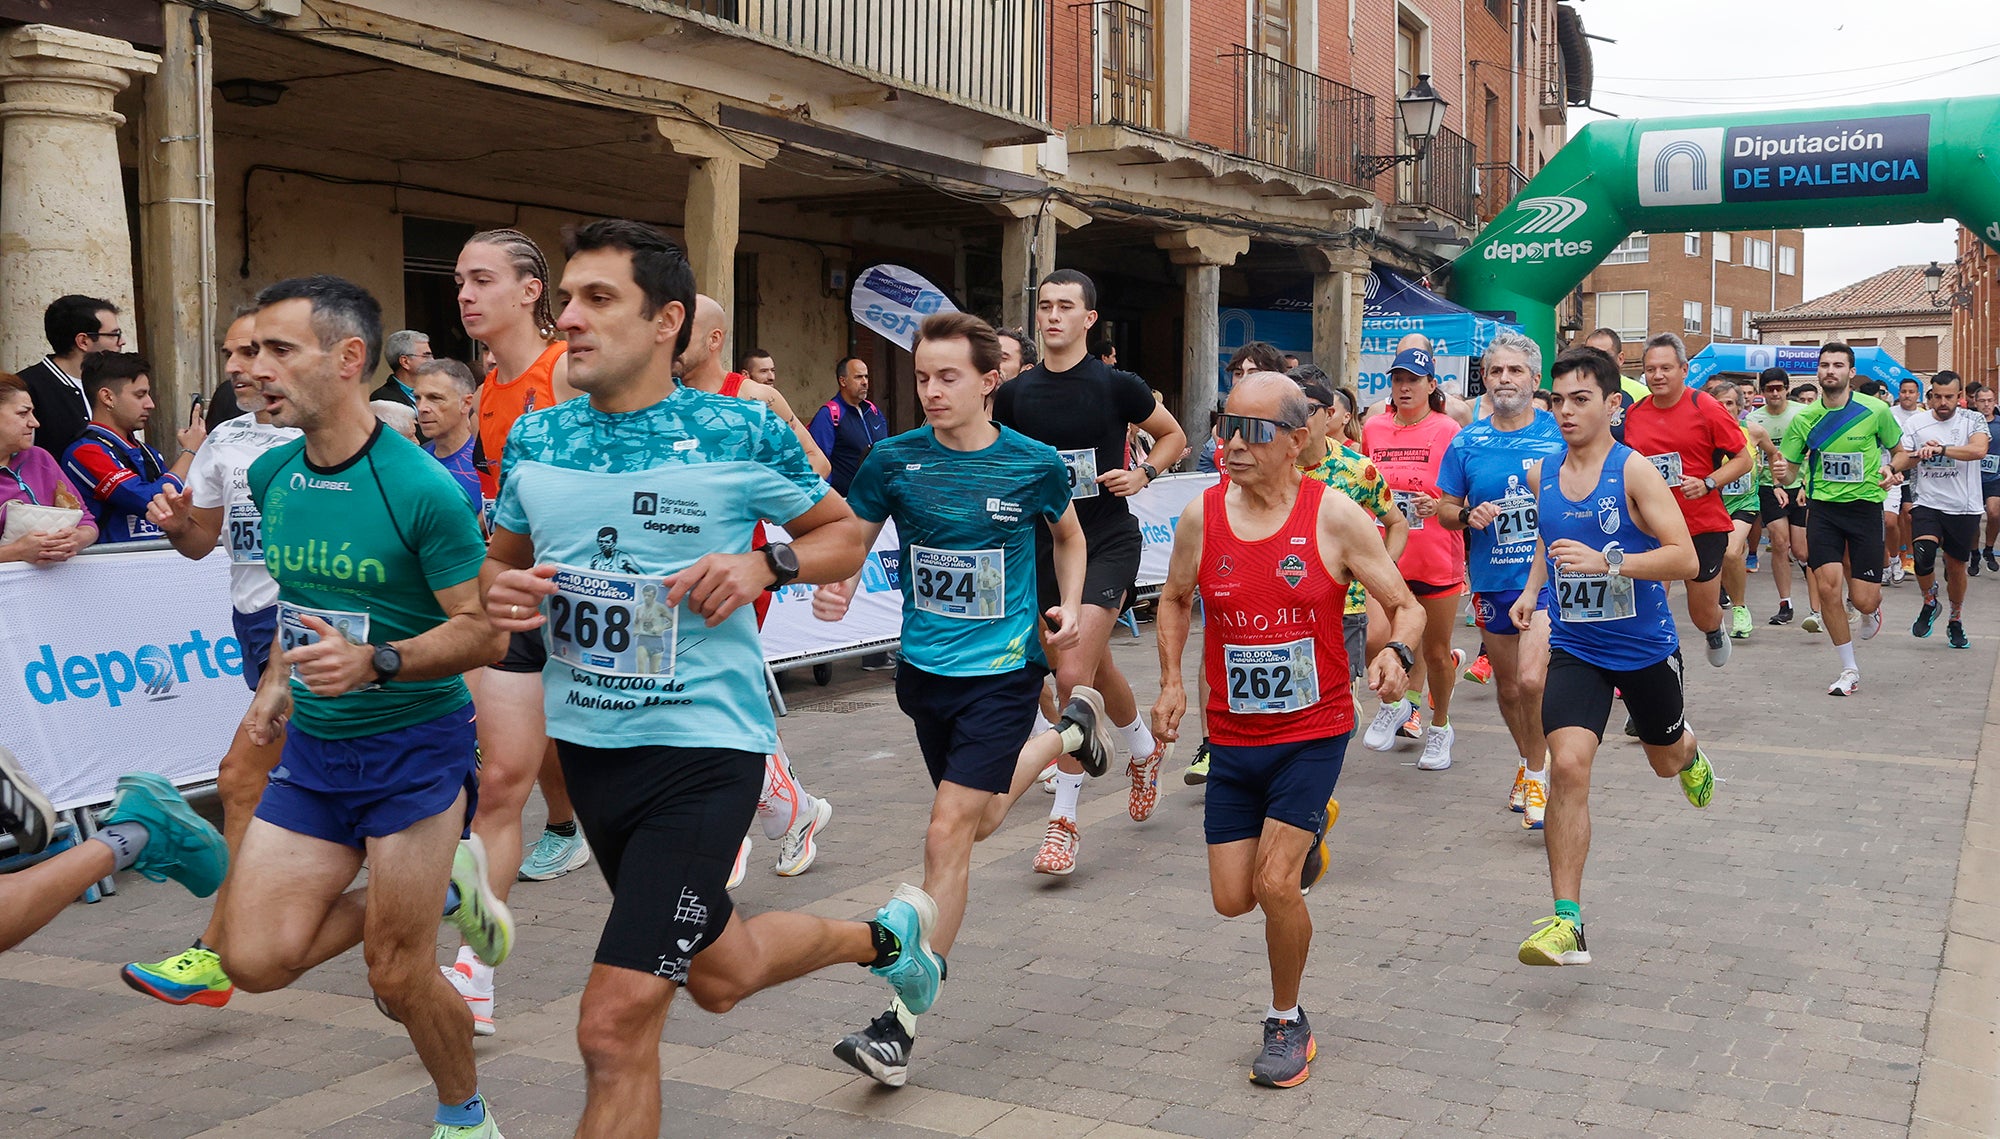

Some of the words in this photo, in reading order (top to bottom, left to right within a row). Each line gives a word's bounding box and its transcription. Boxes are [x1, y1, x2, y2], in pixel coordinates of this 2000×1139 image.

[1733, 129, 1884, 161] Diputación
[1733, 167, 1770, 189] DE
[1779, 159, 1921, 187] PALENCIA
[1483, 238, 1593, 264] deportes
[1823, 461, 1851, 476] 210
[308, 478, 353, 491] LURBEL
[660, 506, 671, 514] DE
[674, 507, 707, 517] PALENCIA
[661, 496, 700, 508] Diputación
[643, 520, 701, 535] deportes
[1497, 508, 1538, 535] 219
[266, 539, 386, 583] gullón
[1489, 555, 1525, 565] Mariano
[1505, 544, 1533, 555] 10.000
[917, 567, 976, 603] 324
[1560, 581, 1608, 609] 247
[551, 594, 631, 654] 268
[1242, 650, 1273, 659] 10.000
[24, 629, 243, 707] deporte
[596, 675, 656, 691] 10.000
[661, 679, 686, 692] de
[1230, 665, 1293, 699] 262
[565, 689, 637, 711] Mariano
